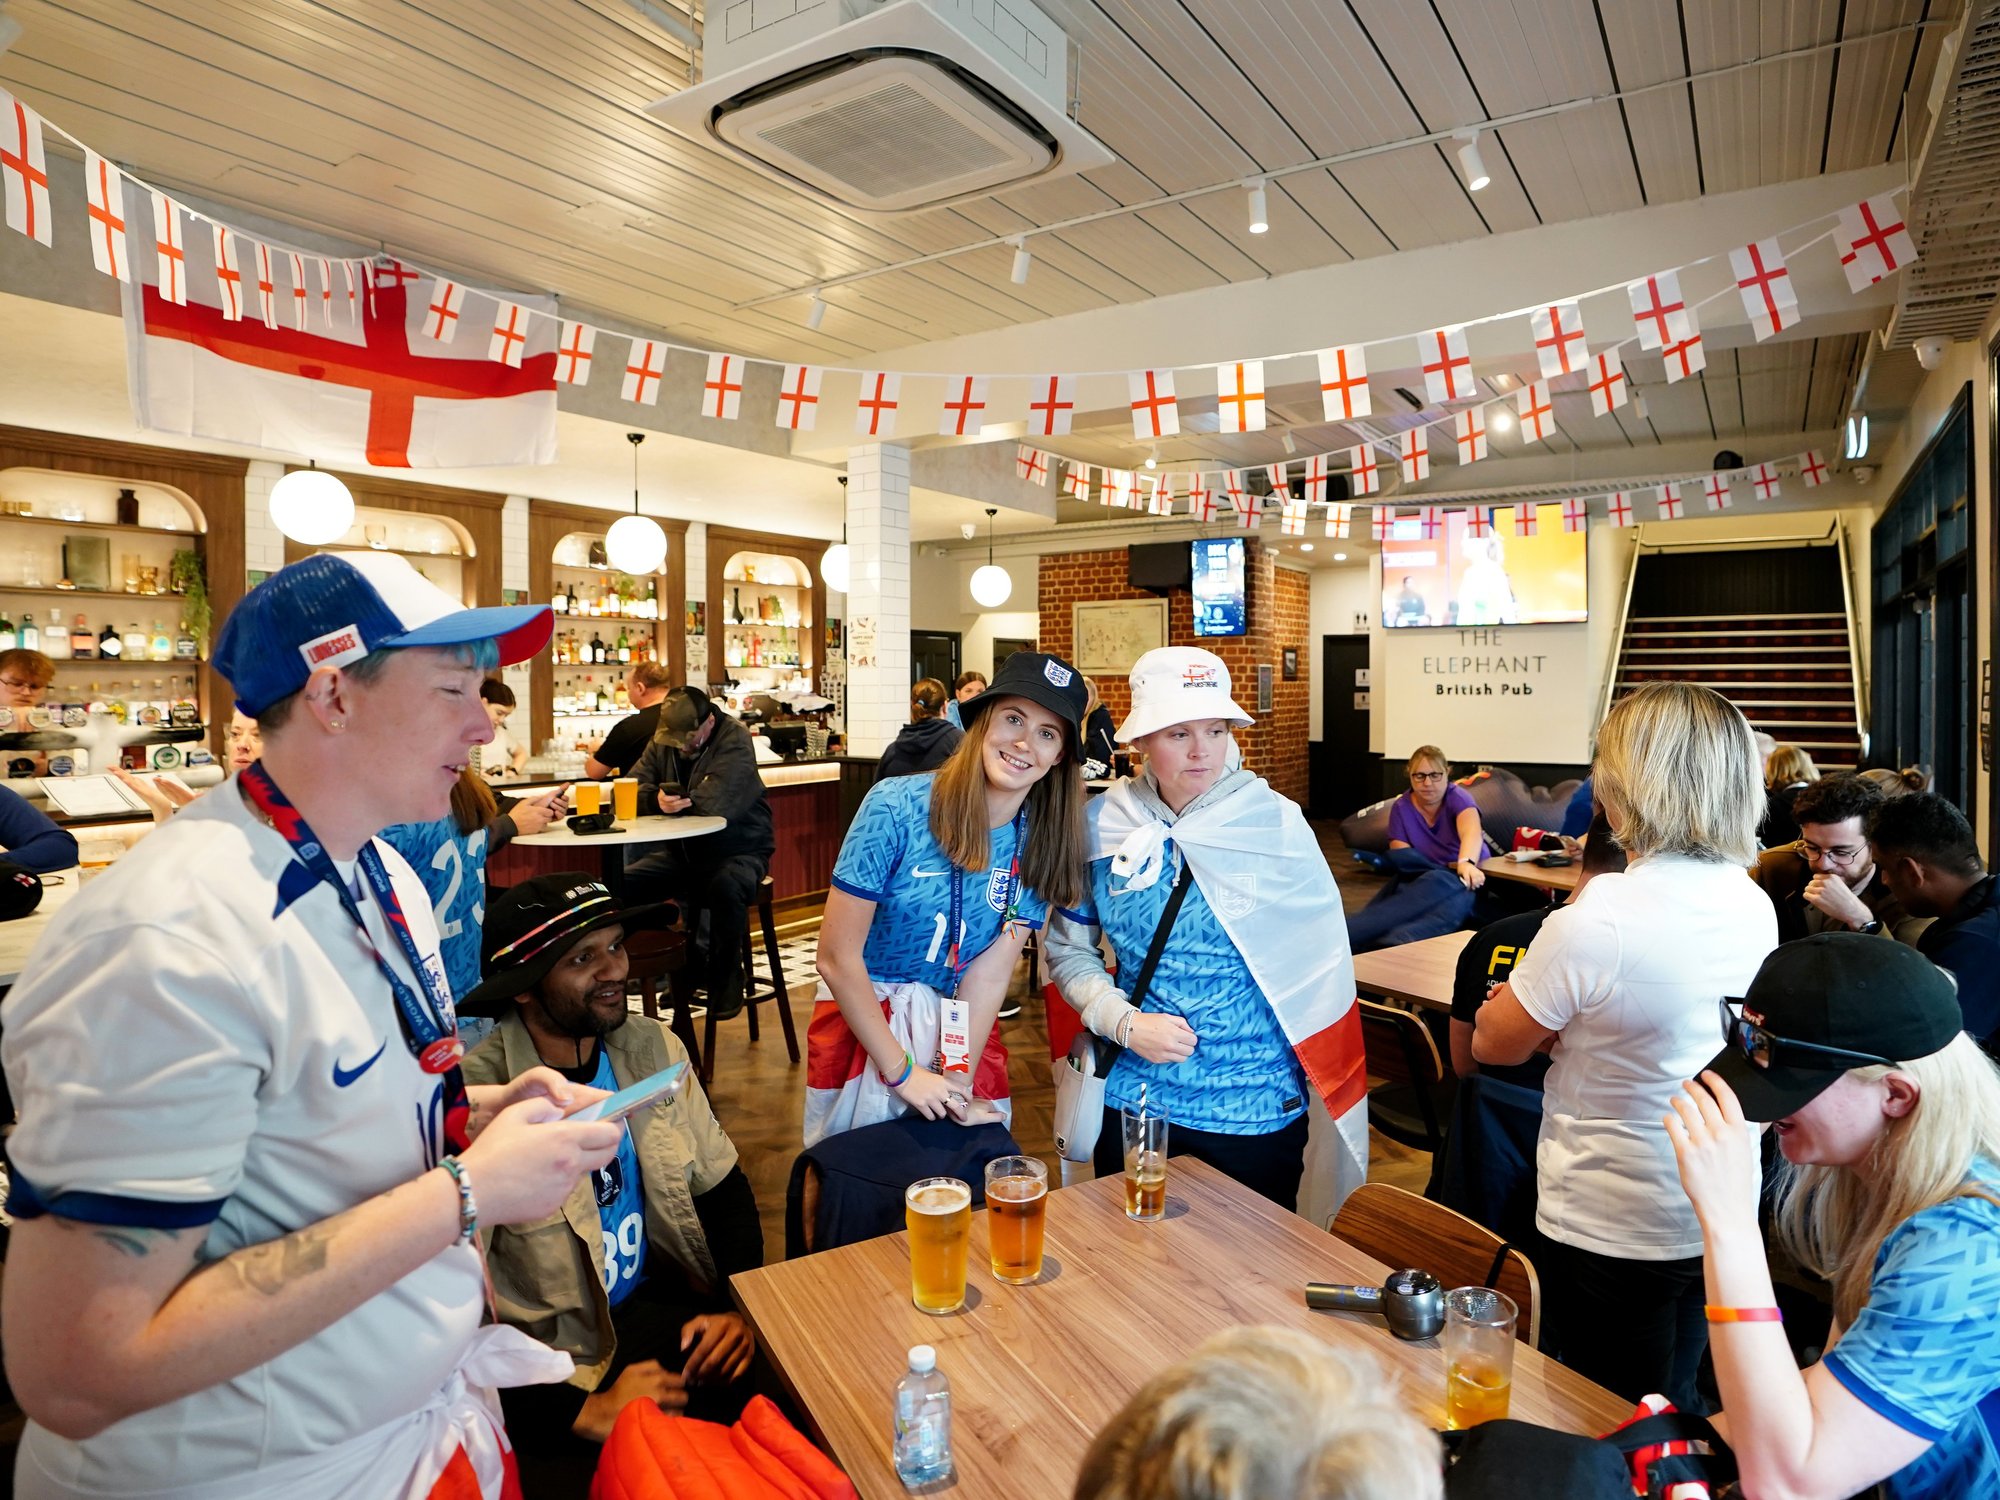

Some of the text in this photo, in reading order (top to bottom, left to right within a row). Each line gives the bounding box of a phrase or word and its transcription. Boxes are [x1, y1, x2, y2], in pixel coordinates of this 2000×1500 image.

[306, 633, 356, 664] LIONESSES
[1456, 629, 1502, 646] THE
[1423, 656, 1547, 673] ELEPHANT
[1436, 683, 1533, 695] British Pub
[953, 871, 961, 895] WORLD
[953, 897, 961, 927] WOMEN'S
[400, 931, 415, 953] CUP
[397, 985, 424, 1027] WORLD
